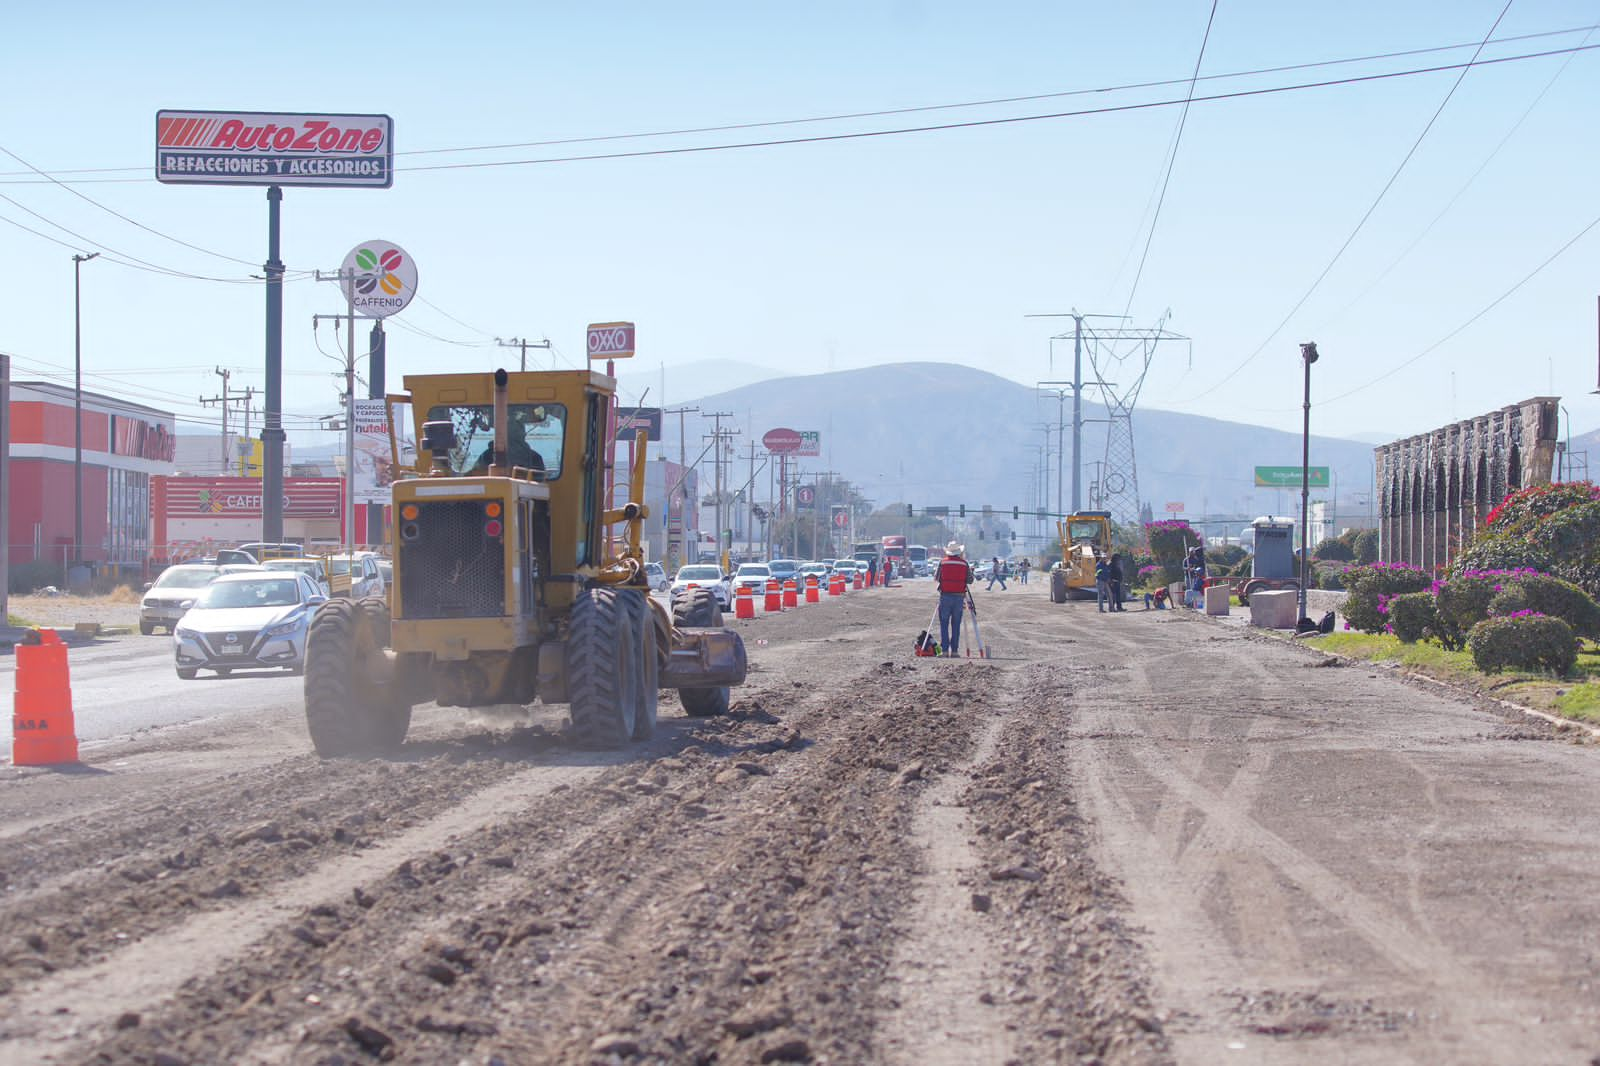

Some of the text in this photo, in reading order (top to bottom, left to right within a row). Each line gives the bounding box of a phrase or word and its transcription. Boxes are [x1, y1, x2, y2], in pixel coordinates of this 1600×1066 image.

[210, 119, 384, 152] AutoZone
[166, 156, 380, 176] REFACCIONES Y ACCESORIOS
[353, 297, 403, 308] CAFFENIO
[588, 326, 626, 351] OXXO
[355, 423, 388, 433] nutell
[227, 495, 290, 509] CAFFO
